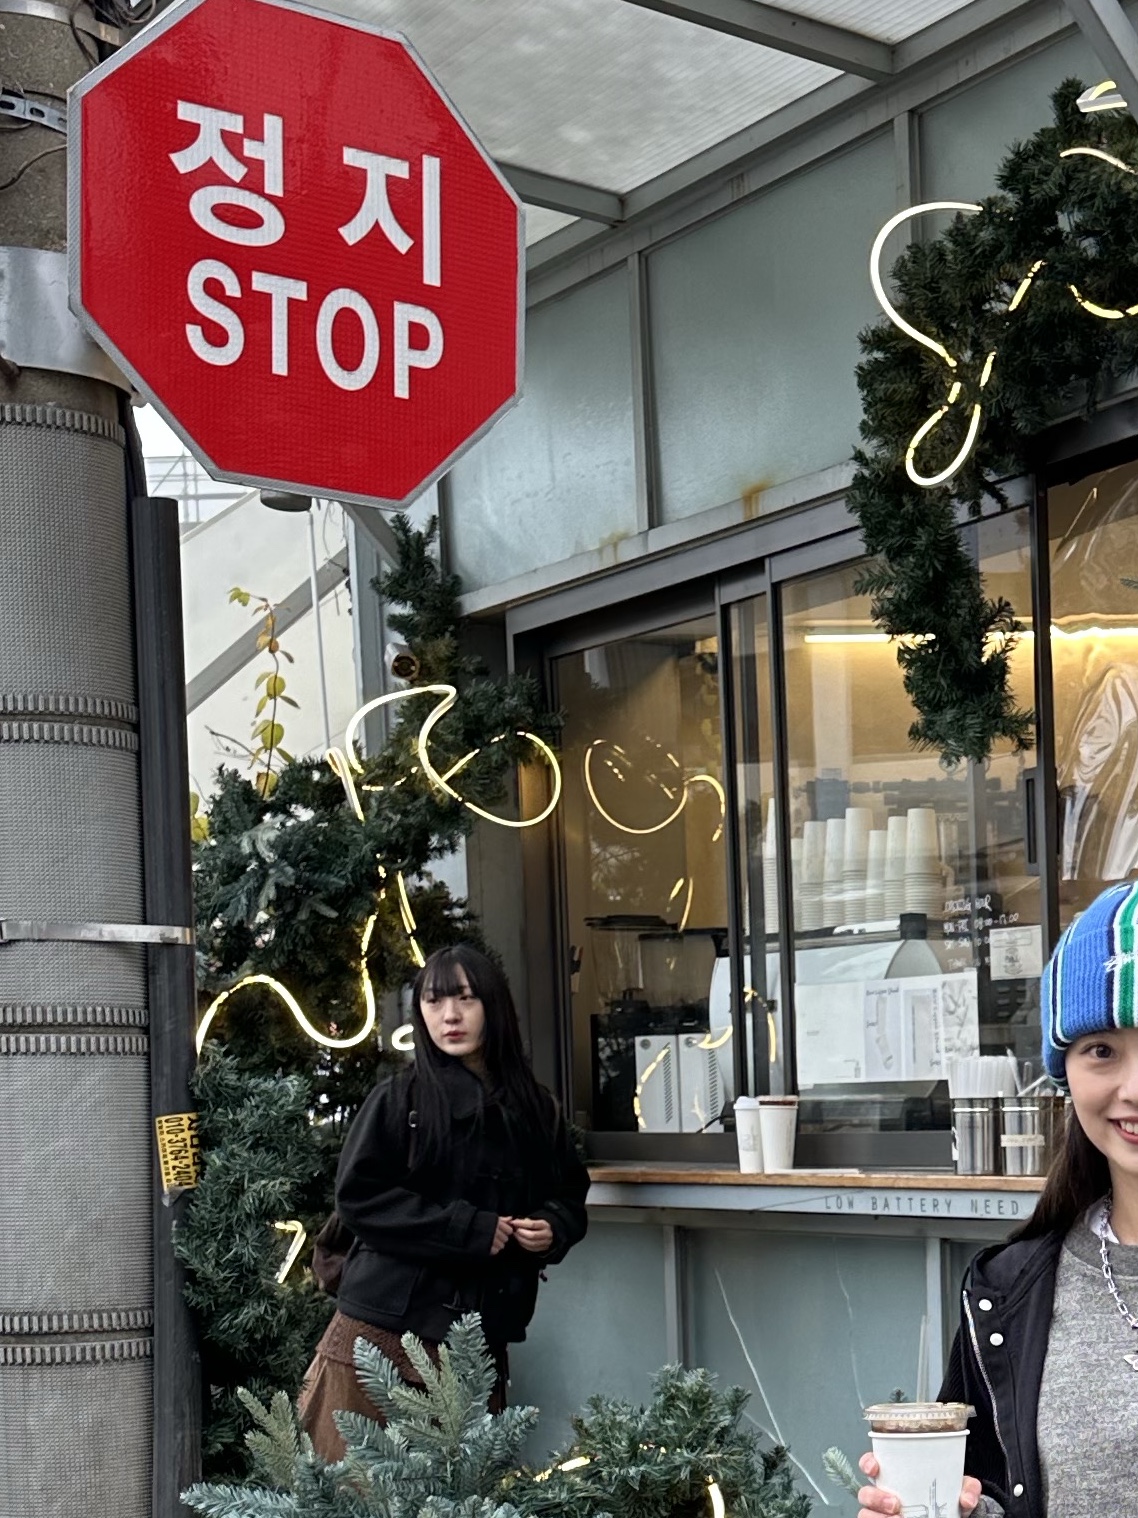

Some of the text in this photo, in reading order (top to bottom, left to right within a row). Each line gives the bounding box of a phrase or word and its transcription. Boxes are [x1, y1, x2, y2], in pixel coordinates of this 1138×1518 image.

[185, 259, 444, 400] STOP
[824, 1196, 1020, 1216] LOW BATTERY NEED
